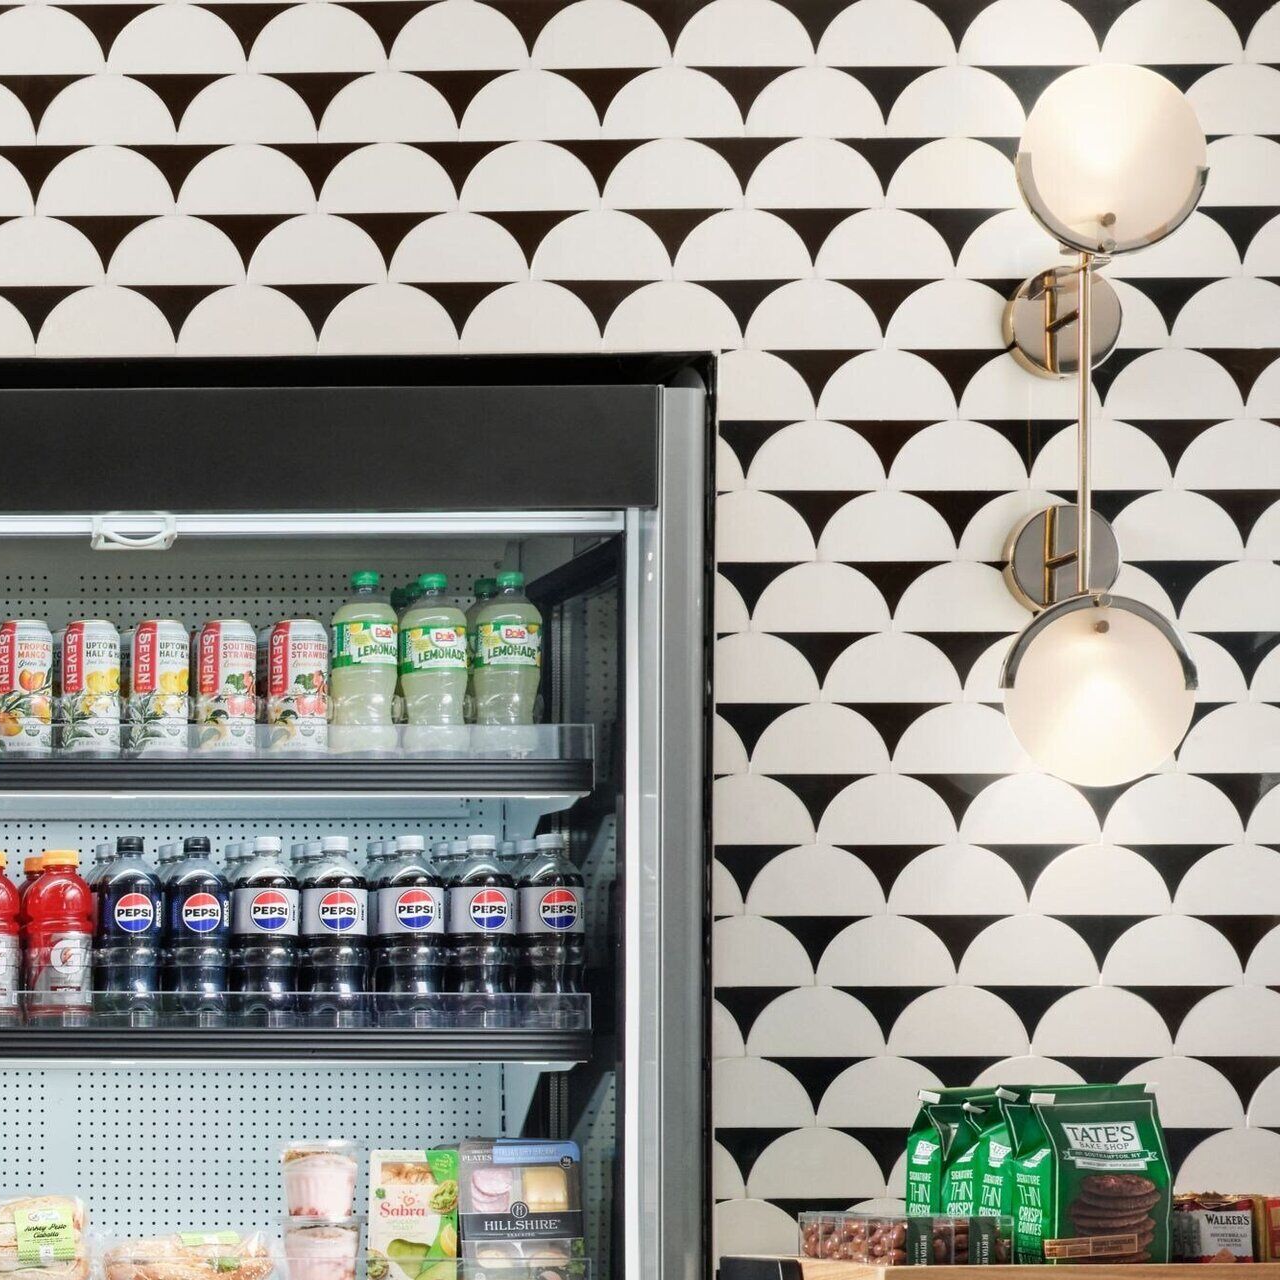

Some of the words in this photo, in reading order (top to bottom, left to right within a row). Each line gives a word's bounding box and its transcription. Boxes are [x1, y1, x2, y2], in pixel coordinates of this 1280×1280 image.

[435, 631, 455, 641] Dole
[505, 628, 525, 638] Dole
[86, 642, 117, 650] UPTOWN
[488, 646, 536, 658] LEMONADE
[0, 634, 11, 685] SEVEN
[66, 634, 78, 684] SEVEN
[138, 633, 151, 684] SEVEN
[203, 634, 214, 685] SEVEN
[273, 634, 284, 685] SEVEN
[117, 908, 151, 917] PEPSI
[185, 908, 219, 917] PEPSI
[253, 906, 288, 915] PEPSI
[321, 906, 356, 915] PEPSI
[398, 905, 433, 914] PEPSI
[472, 905, 506, 914] PEPSI
[542, 906, 576, 914] PEPSI
[1067, 1126, 1134, 1143] TATE'S
[1104, 1142, 1129, 1150] SHOP
[462, 1154, 492, 1162] PLATES
[910, 1182, 930, 1202] THIN
[952, 1181, 973, 1201] THIN
[1019, 1185, 1040, 1206] THIN
[380, 1201, 425, 1217] Sabra
[1019, 1207, 1042, 1221] CRISPY
[1205, 1214, 1250, 1225] WALKER'S
[484, 1220, 558, 1231] HILLSHIRE
[1018, 1221, 1042, 1235] COOKIES
